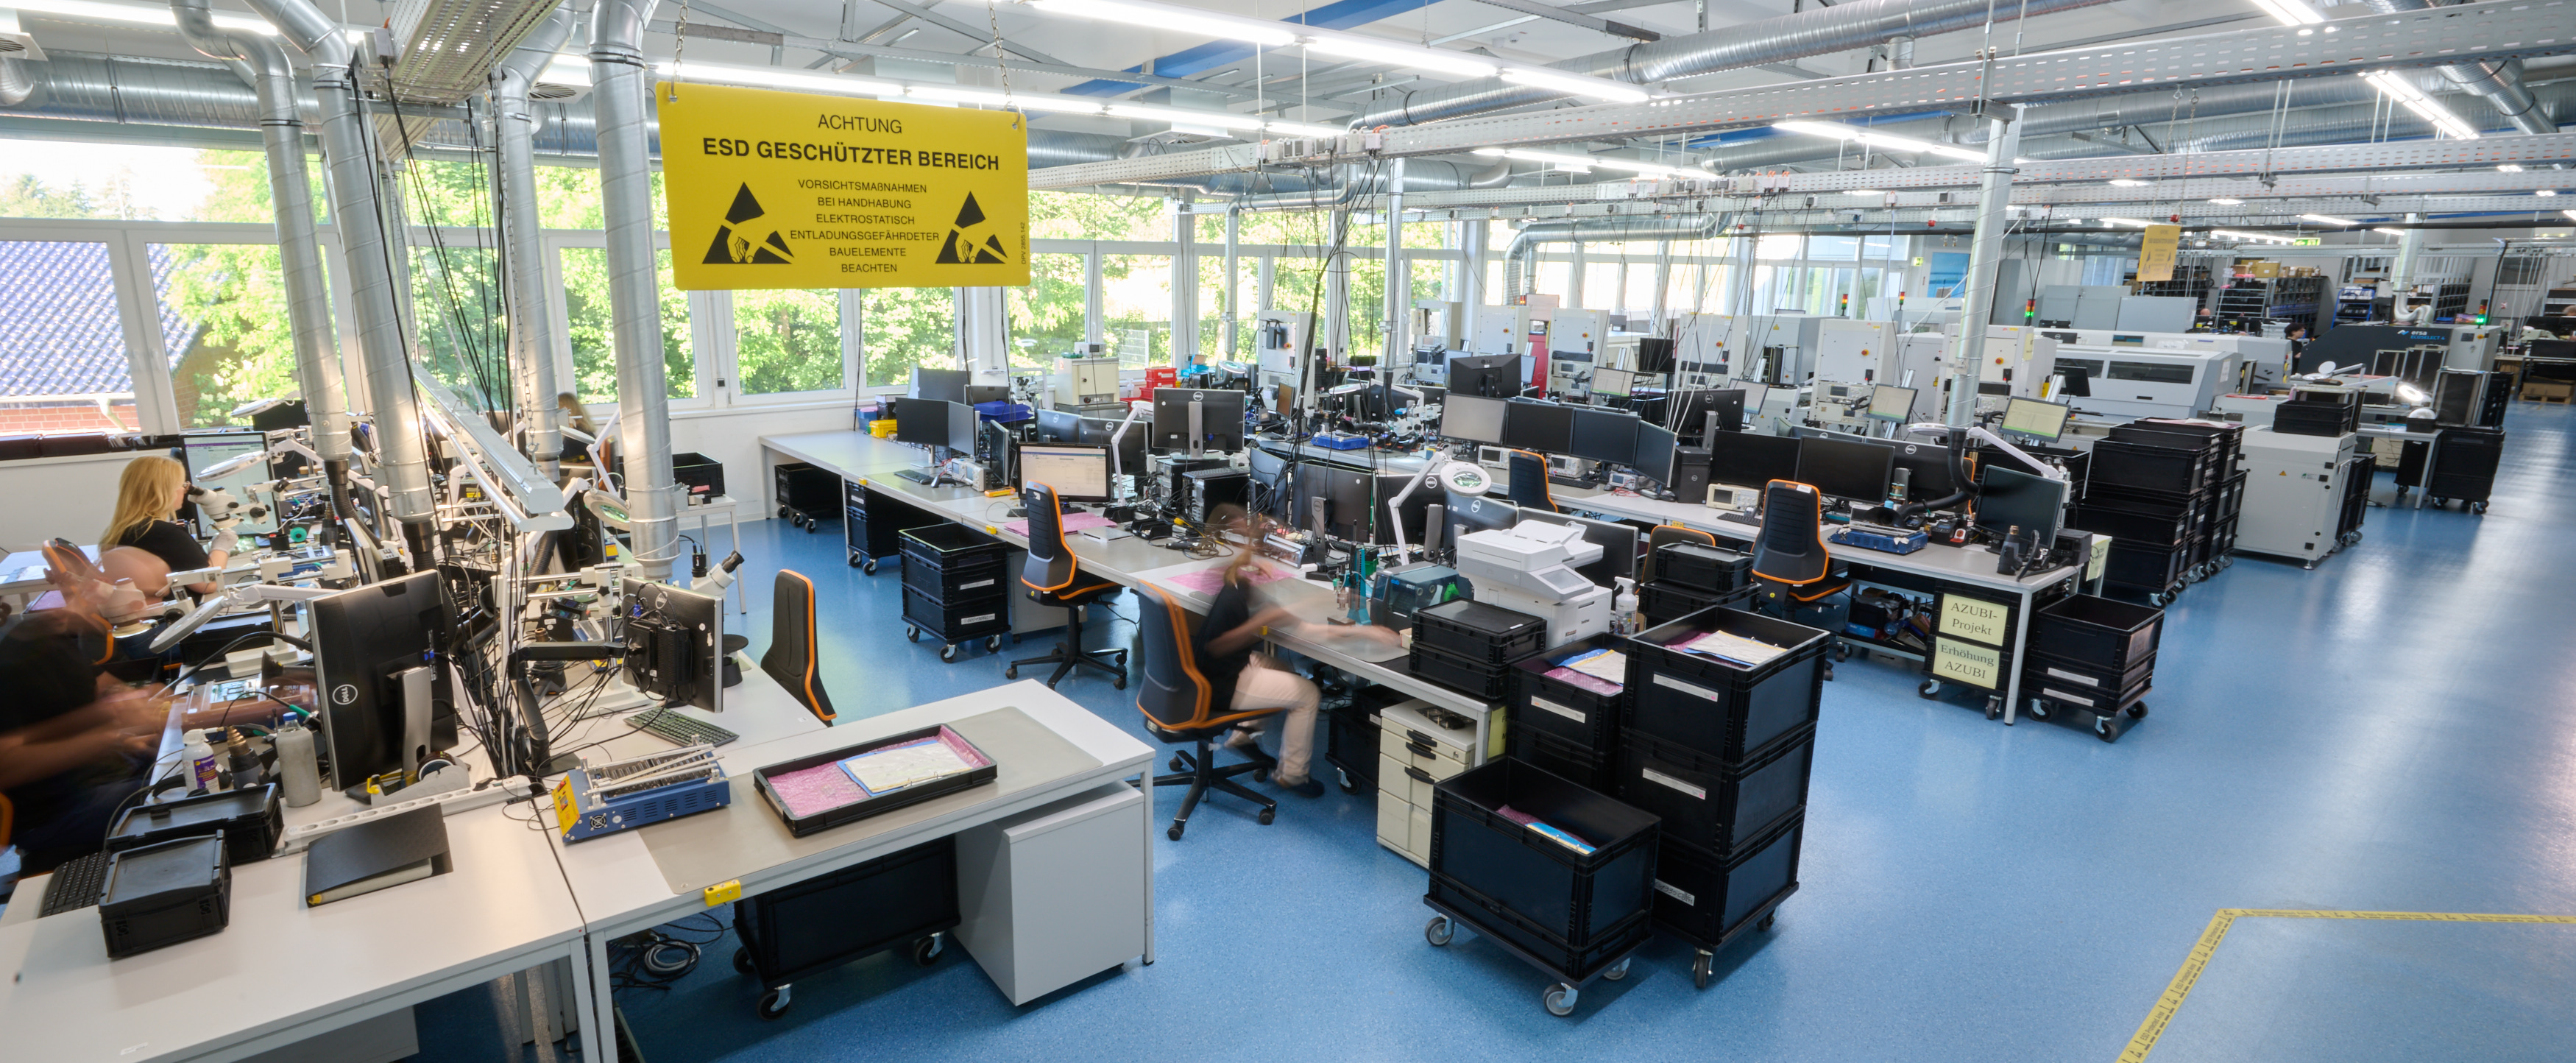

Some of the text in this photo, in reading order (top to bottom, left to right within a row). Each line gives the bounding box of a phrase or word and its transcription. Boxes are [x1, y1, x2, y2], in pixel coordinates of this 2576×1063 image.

[818, 114, 902, 134] ACHTUNG
[703, 138, 999, 171] ESD GESCHÜTZTER BEREICH
[818, 197, 911, 209] BEI HANDHABUNG
[816, 213, 915, 225] ELEKTROSTATISCH
[790, 230, 939, 241] ENTLADUNGSGEFÄHRDETER
[829, 247, 906, 257] BAUELEMENTE
[841, 264, 897, 272] BEACHTEN
[1950, 602, 1998, 619] AZUBI-
[1952, 618, 1992, 635] Projekt
[1941, 644, 1995, 667] Erhöhung
[1945, 661, 1986, 679] AZUBI
